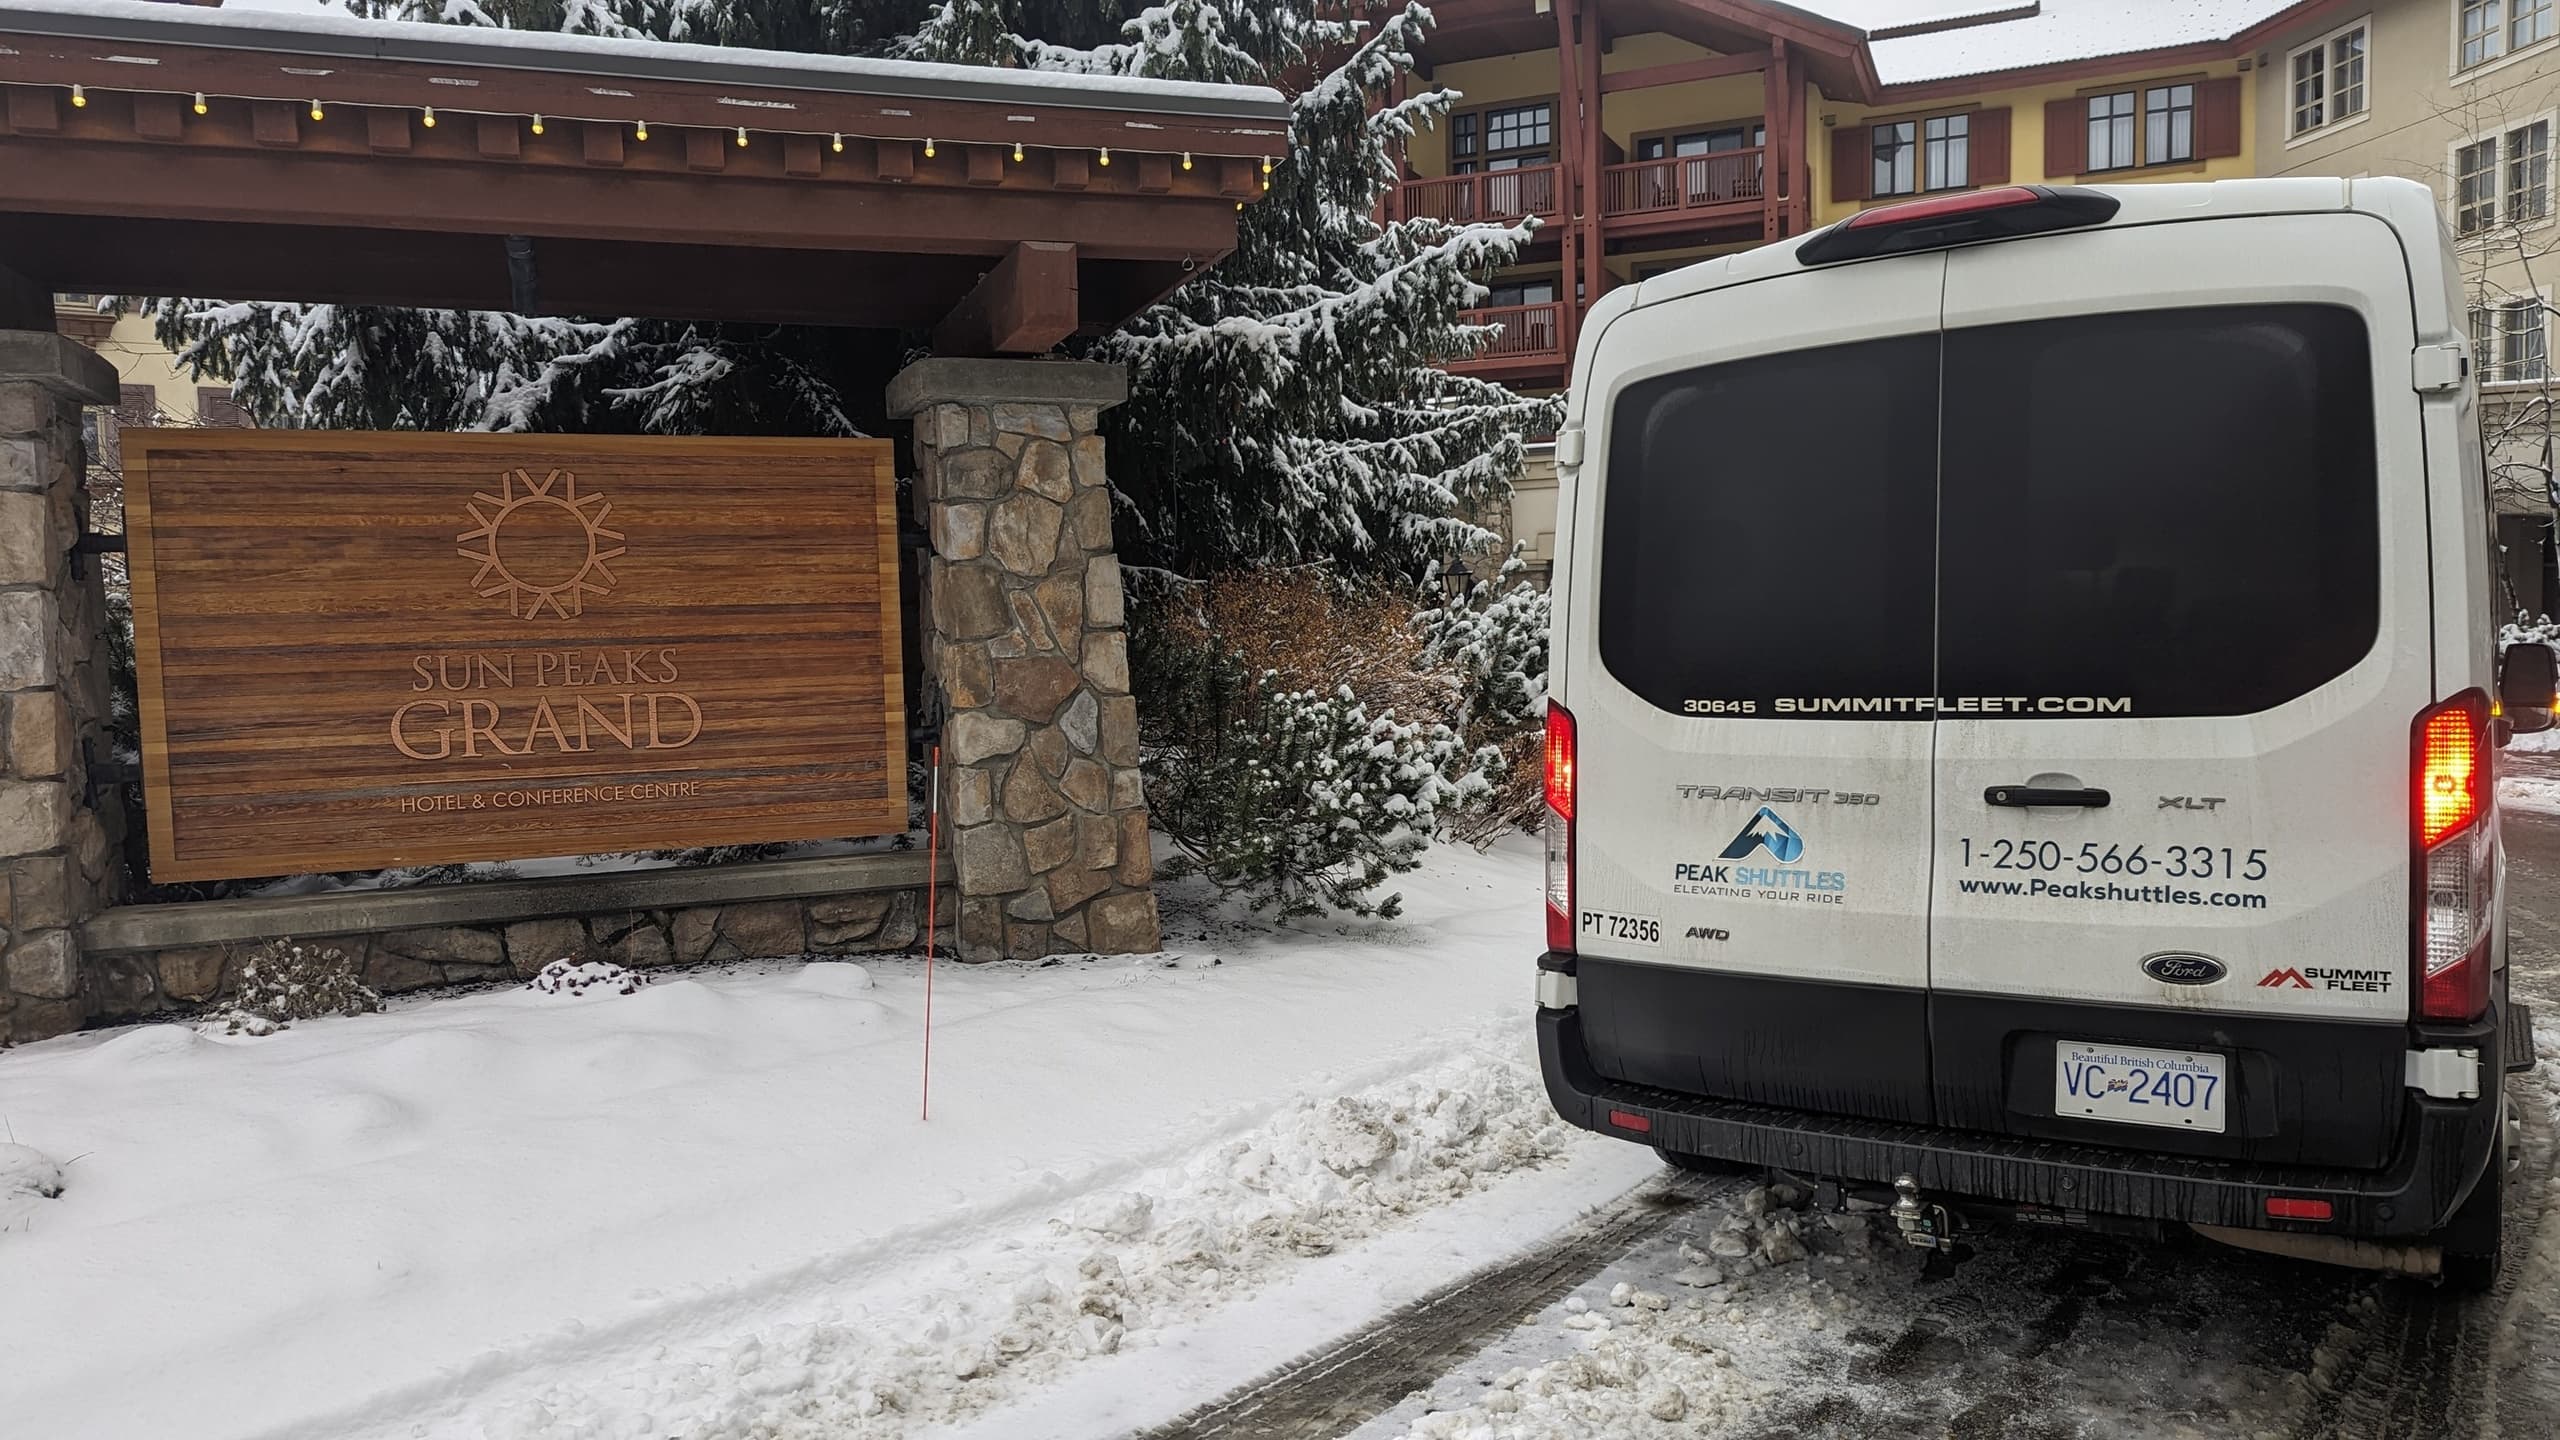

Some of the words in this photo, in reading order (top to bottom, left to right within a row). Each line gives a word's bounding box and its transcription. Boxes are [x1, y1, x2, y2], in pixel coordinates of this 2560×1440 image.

[412, 653, 515, 692] SUN
[534, 648, 679, 687] PEAKS
[1684, 700, 1756, 713] 30645
[1774, 697, 2131, 712] SUMMITFLEET.COM
[390, 692, 703, 760] GRAND
[401, 794, 466, 813] HOTEL
[472, 793, 487, 810] &
[492, 785, 625, 808] CONFERENCE
[630, 781, 699, 800] CENTRE
[1676, 785, 1830, 803] TRANSIT
[1833, 791, 1880, 805] 350
[2158, 796, 2226, 810] XLT
[1961, 838, 2268, 881] 1-250-566-3315
[1675, 864, 1729, 883] PEAK
[1735, 866, 1845, 892] SHUTTLES
[1674, 884, 1751, 898] ELEVATING
[1758, 890, 1800, 901] YOUR
[1806, 893, 1844, 905] RIDE
[1959, 878, 2267, 909] www.Peakshuttles.com
[1582, 911, 1603, 934] PT
[1609, 916, 1660, 942] 72356
[1685, 927, 1730, 941] AWD
[2160, 959, 2206, 978] Ford
[2304, 967, 2392, 982] SUMMIT
[2327, 980, 2392, 993] FLEET
[2071, 1051, 2118, 1065] Beautiful
[2120, 1056, 2154, 1069] British
[2156, 1060, 2209, 1073] Columbia
[2064, 1061, 2106, 1099] VC
[2128, 1068, 2219, 1111] 2407
